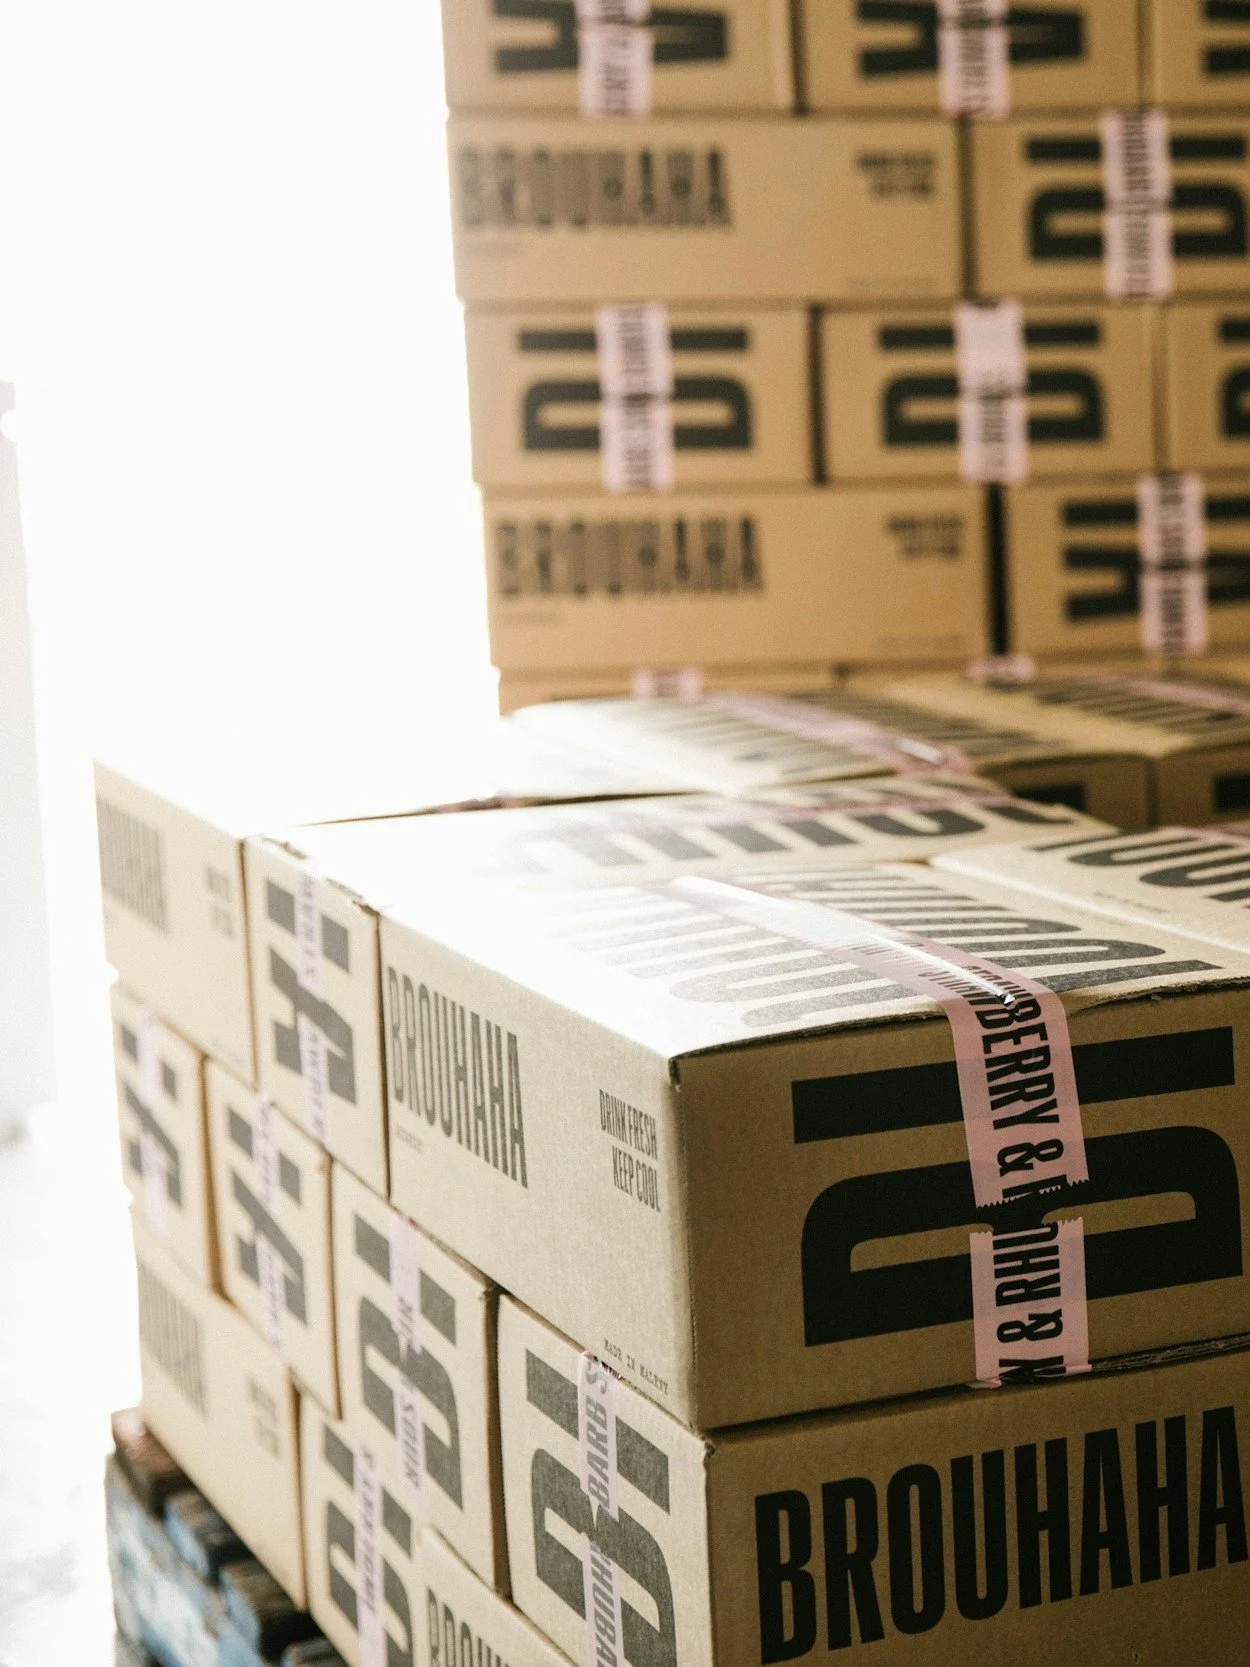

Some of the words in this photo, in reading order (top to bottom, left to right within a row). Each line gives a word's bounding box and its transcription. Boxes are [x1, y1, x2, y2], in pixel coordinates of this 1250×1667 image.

[387, 966, 528, 1190] BROUHAHA
[599, 1088, 628, 1145] DRINK
[627, 1104, 658, 1161] FRESH
[996, 1138, 1064, 1175] &
[612, 1145, 634, 1198] KEEP
[635, 1161, 661, 1212] COOL
[996, 1308, 1063, 1342] &
[754, 1406, 1249, 1666] BROUHAHA
